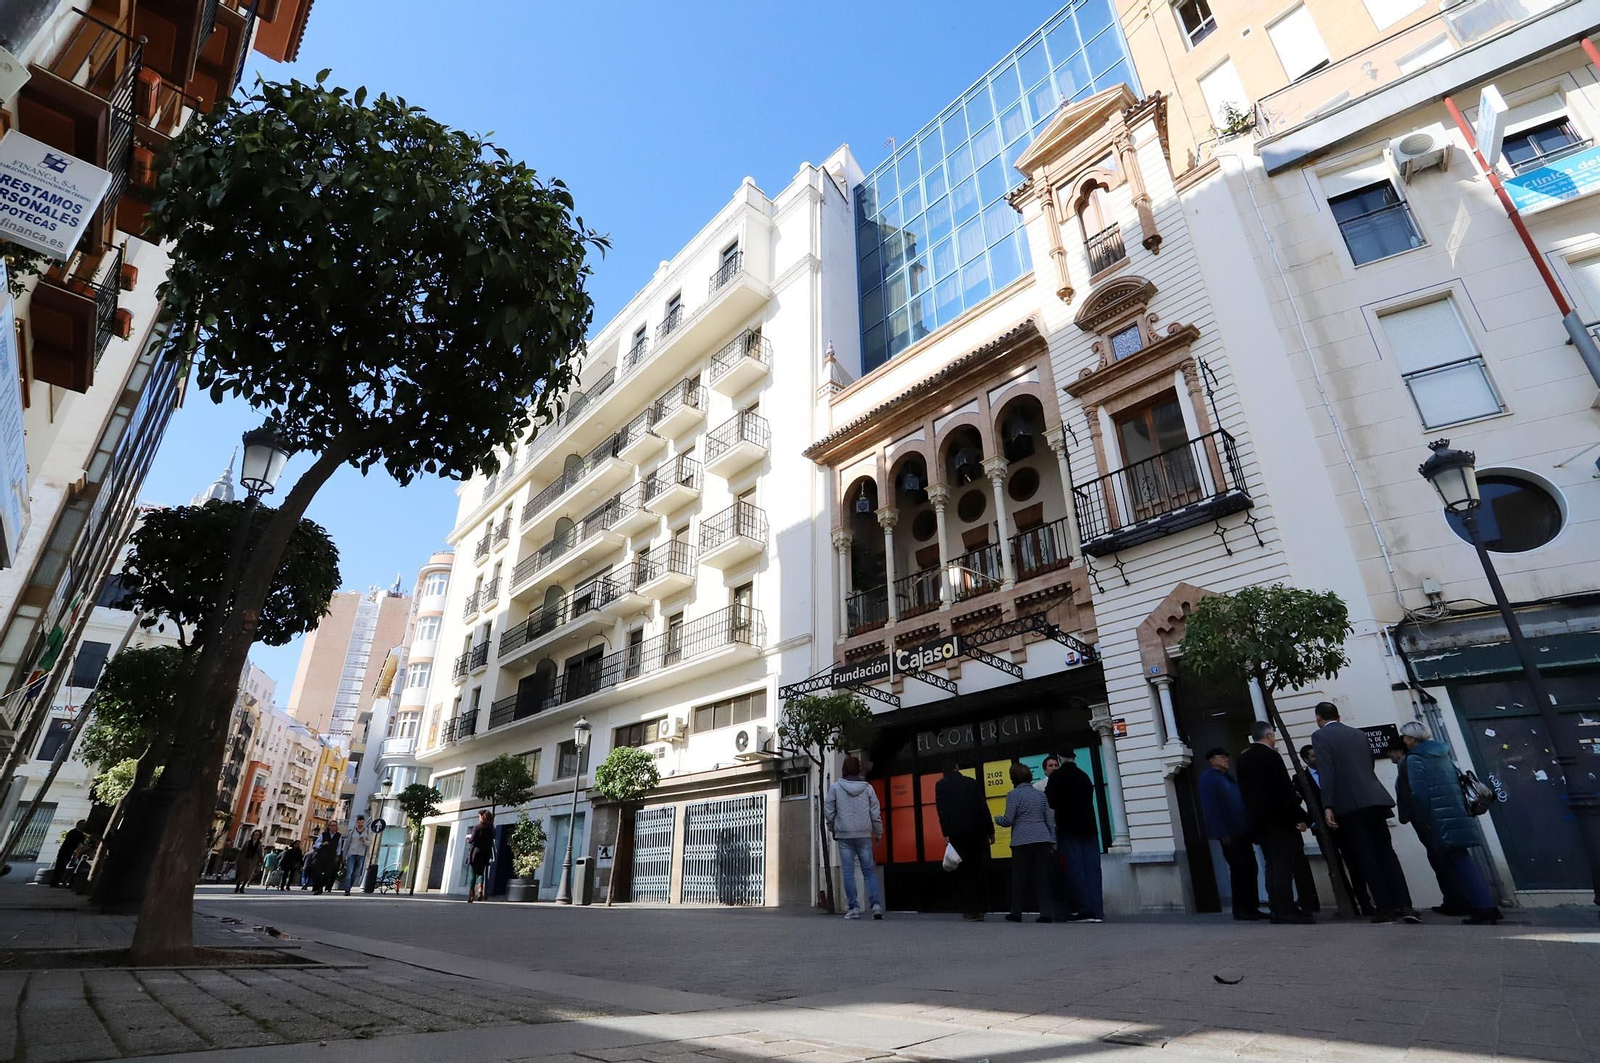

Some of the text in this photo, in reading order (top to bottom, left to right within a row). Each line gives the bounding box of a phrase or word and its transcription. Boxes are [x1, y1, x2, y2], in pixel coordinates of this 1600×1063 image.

[0, 163, 37, 180] TABLECIMIENTO
[0, 173, 83, 214] RESTAMOS
[61, 180, 79, 192] S.A.
[833, 636, 959, 685] Fundación Cajasol
[917, 714, 1044, 751] EL COMERCIAL
[987, 771, 1003, 779] 21.02
[988, 779, 1004, 787] 21.03
